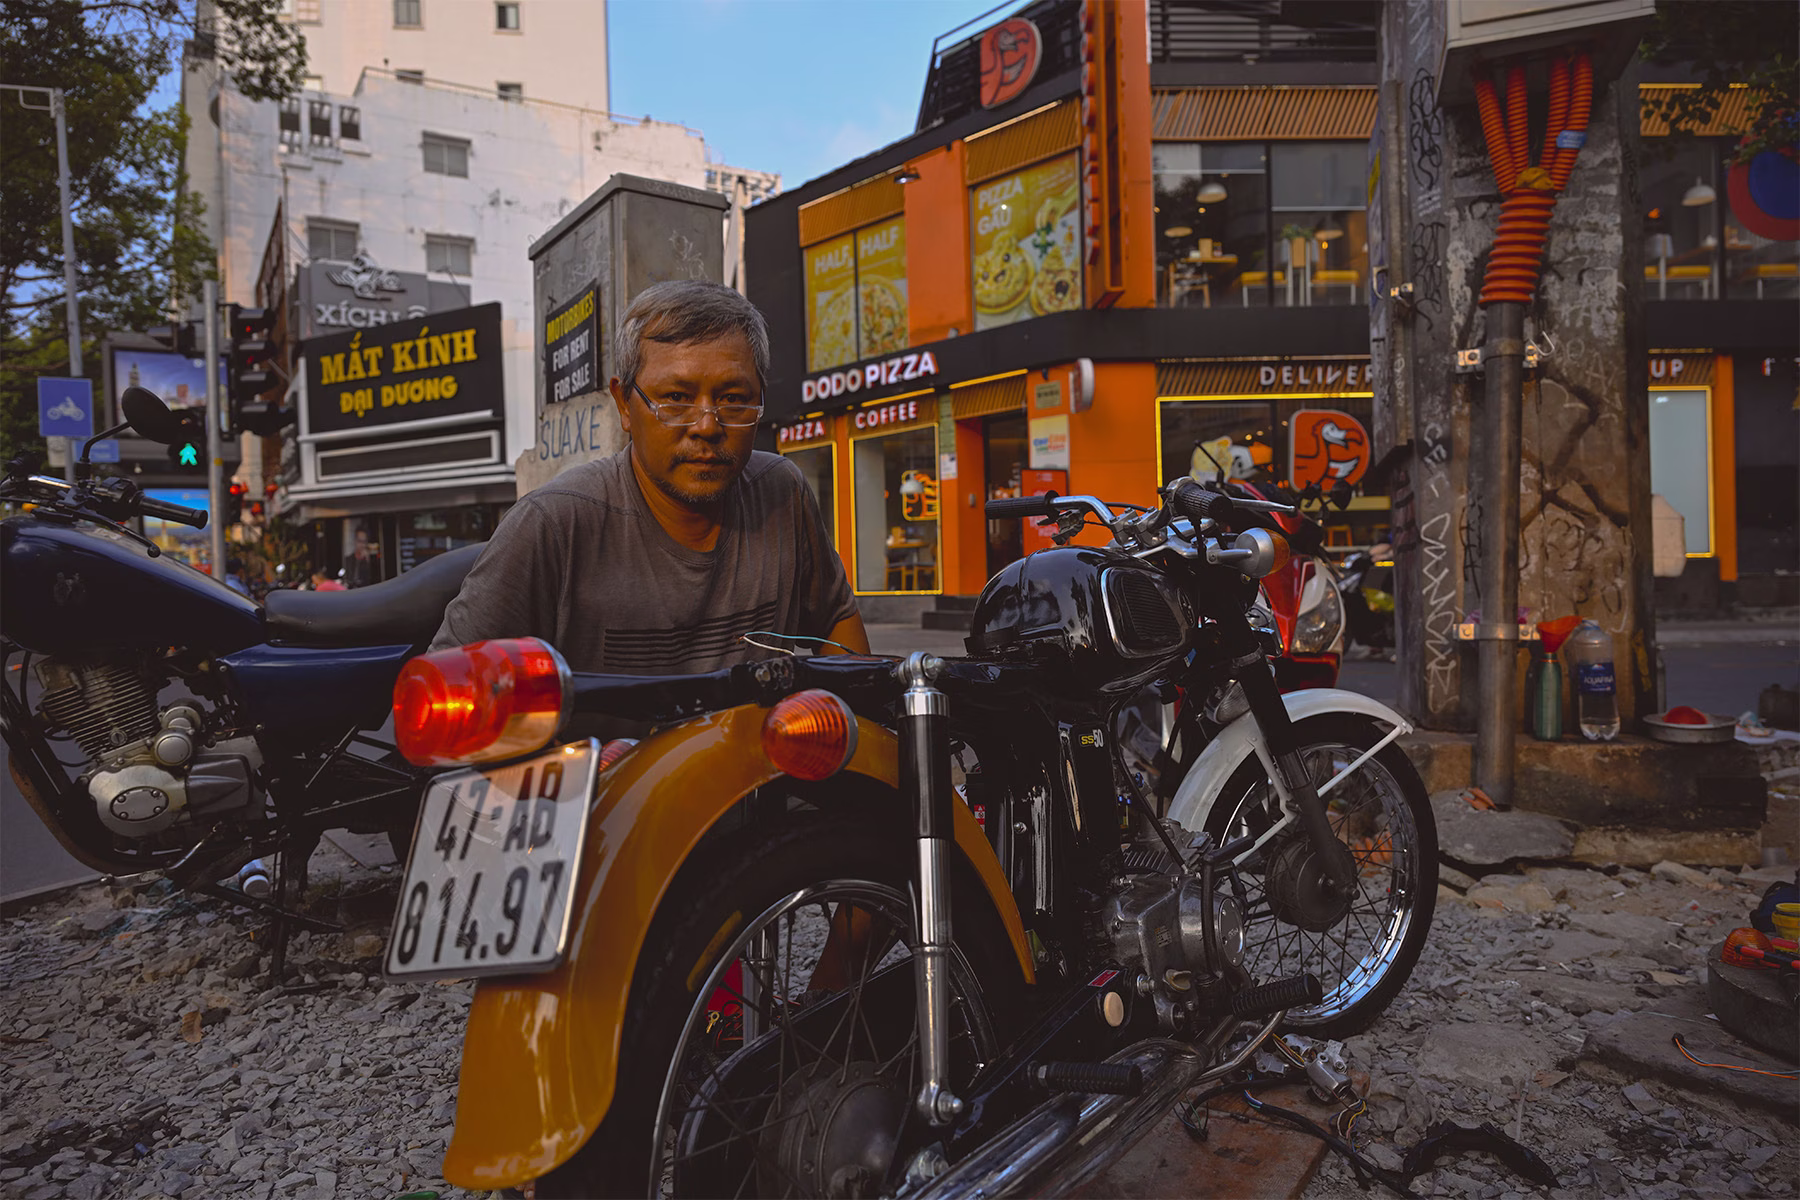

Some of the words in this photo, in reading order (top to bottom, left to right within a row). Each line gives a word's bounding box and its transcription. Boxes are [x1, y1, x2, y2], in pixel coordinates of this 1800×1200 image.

[978, 176, 1024, 210] PIZZA
[860, 225, 899, 258] HALF
[316, 300, 387, 328] XÍCH
[546, 289, 595, 345] MOTORBIKES
[319, 330, 384, 385] MẮT
[391, 326, 478, 374] KÍNH
[552, 345, 570, 372] FOR
[570, 328, 590, 362] RENT
[1650, 358, 1684, 378] UP
[340, 387, 374, 418] ĐẠI
[381, 375, 459, 408] DƯƠNG
[553, 376, 571, 403] FOR
[571, 362, 591, 393] SALE
[802, 368, 863, 403] DODO
[865, 351, 938, 389] PIZZA
[779, 420, 825, 443] PIZZA
[855, 401, 918, 429] COFFEE
[434, 761, 564, 861] 47-AB
[397, 859, 566, 965] 814.97
